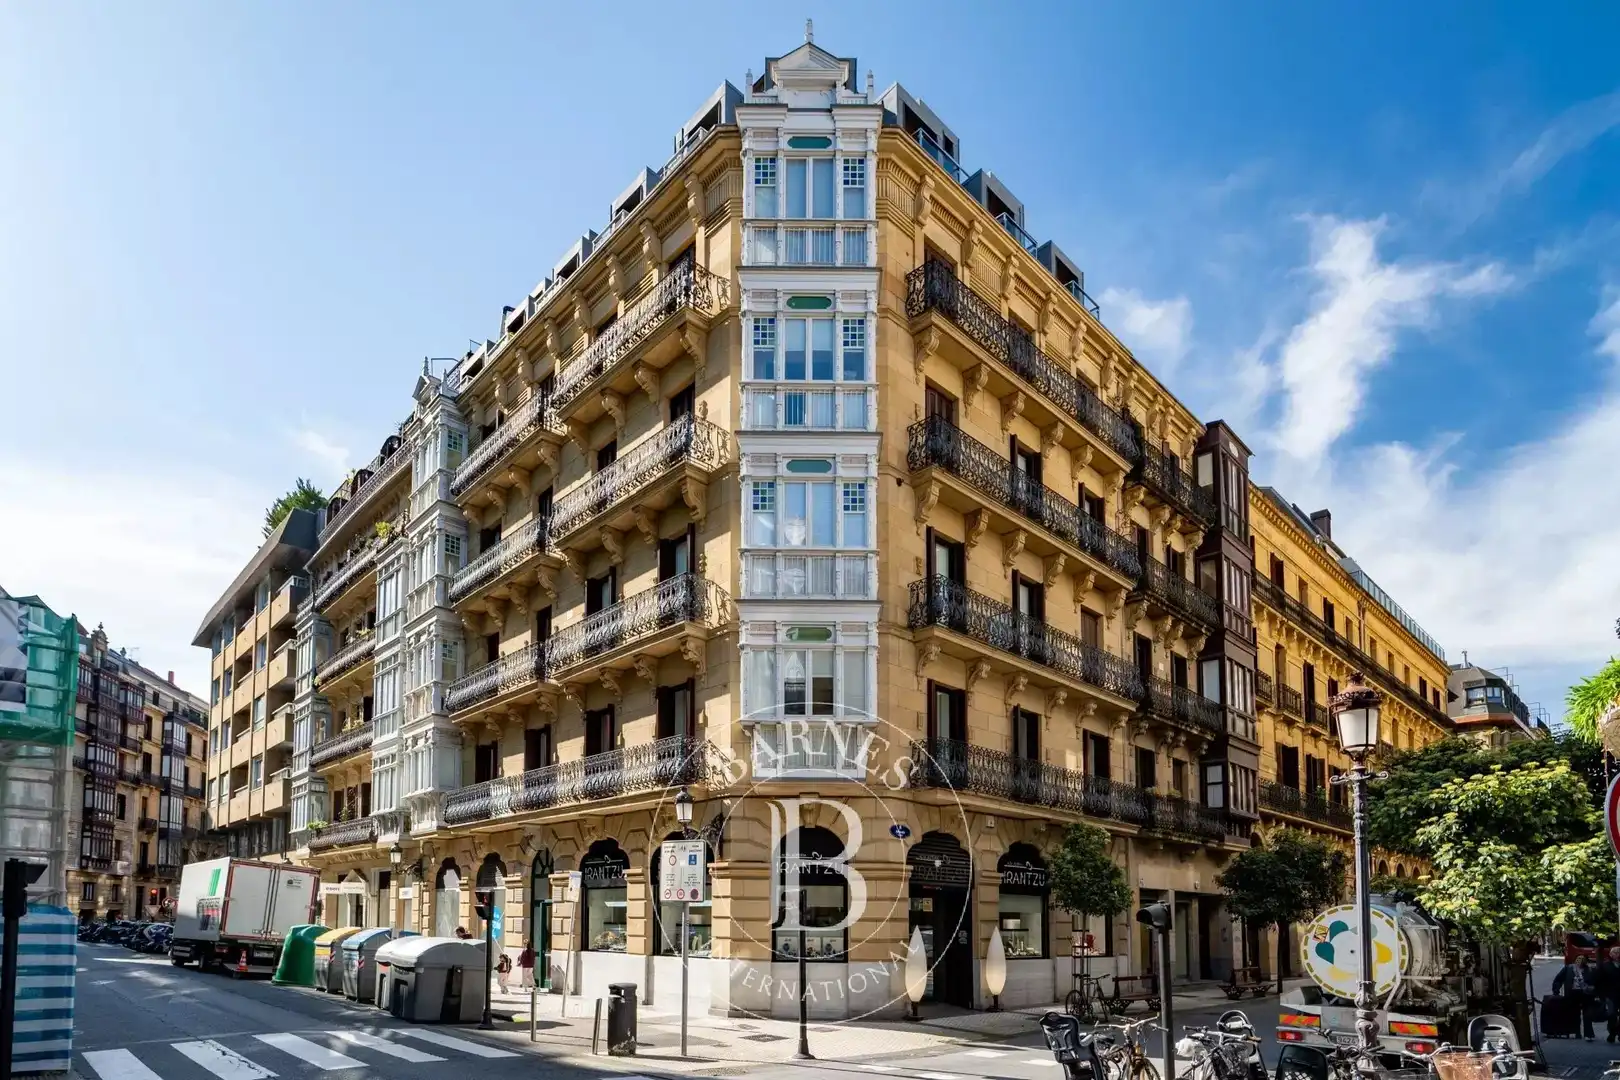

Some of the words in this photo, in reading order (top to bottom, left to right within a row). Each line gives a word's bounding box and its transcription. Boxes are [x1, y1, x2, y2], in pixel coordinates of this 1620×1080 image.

[585, 864, 624, 880] IRANTZU
[776, 861, 844, 875] IRANTZU
[1003, 870, 1045, 887] IRANTZU
